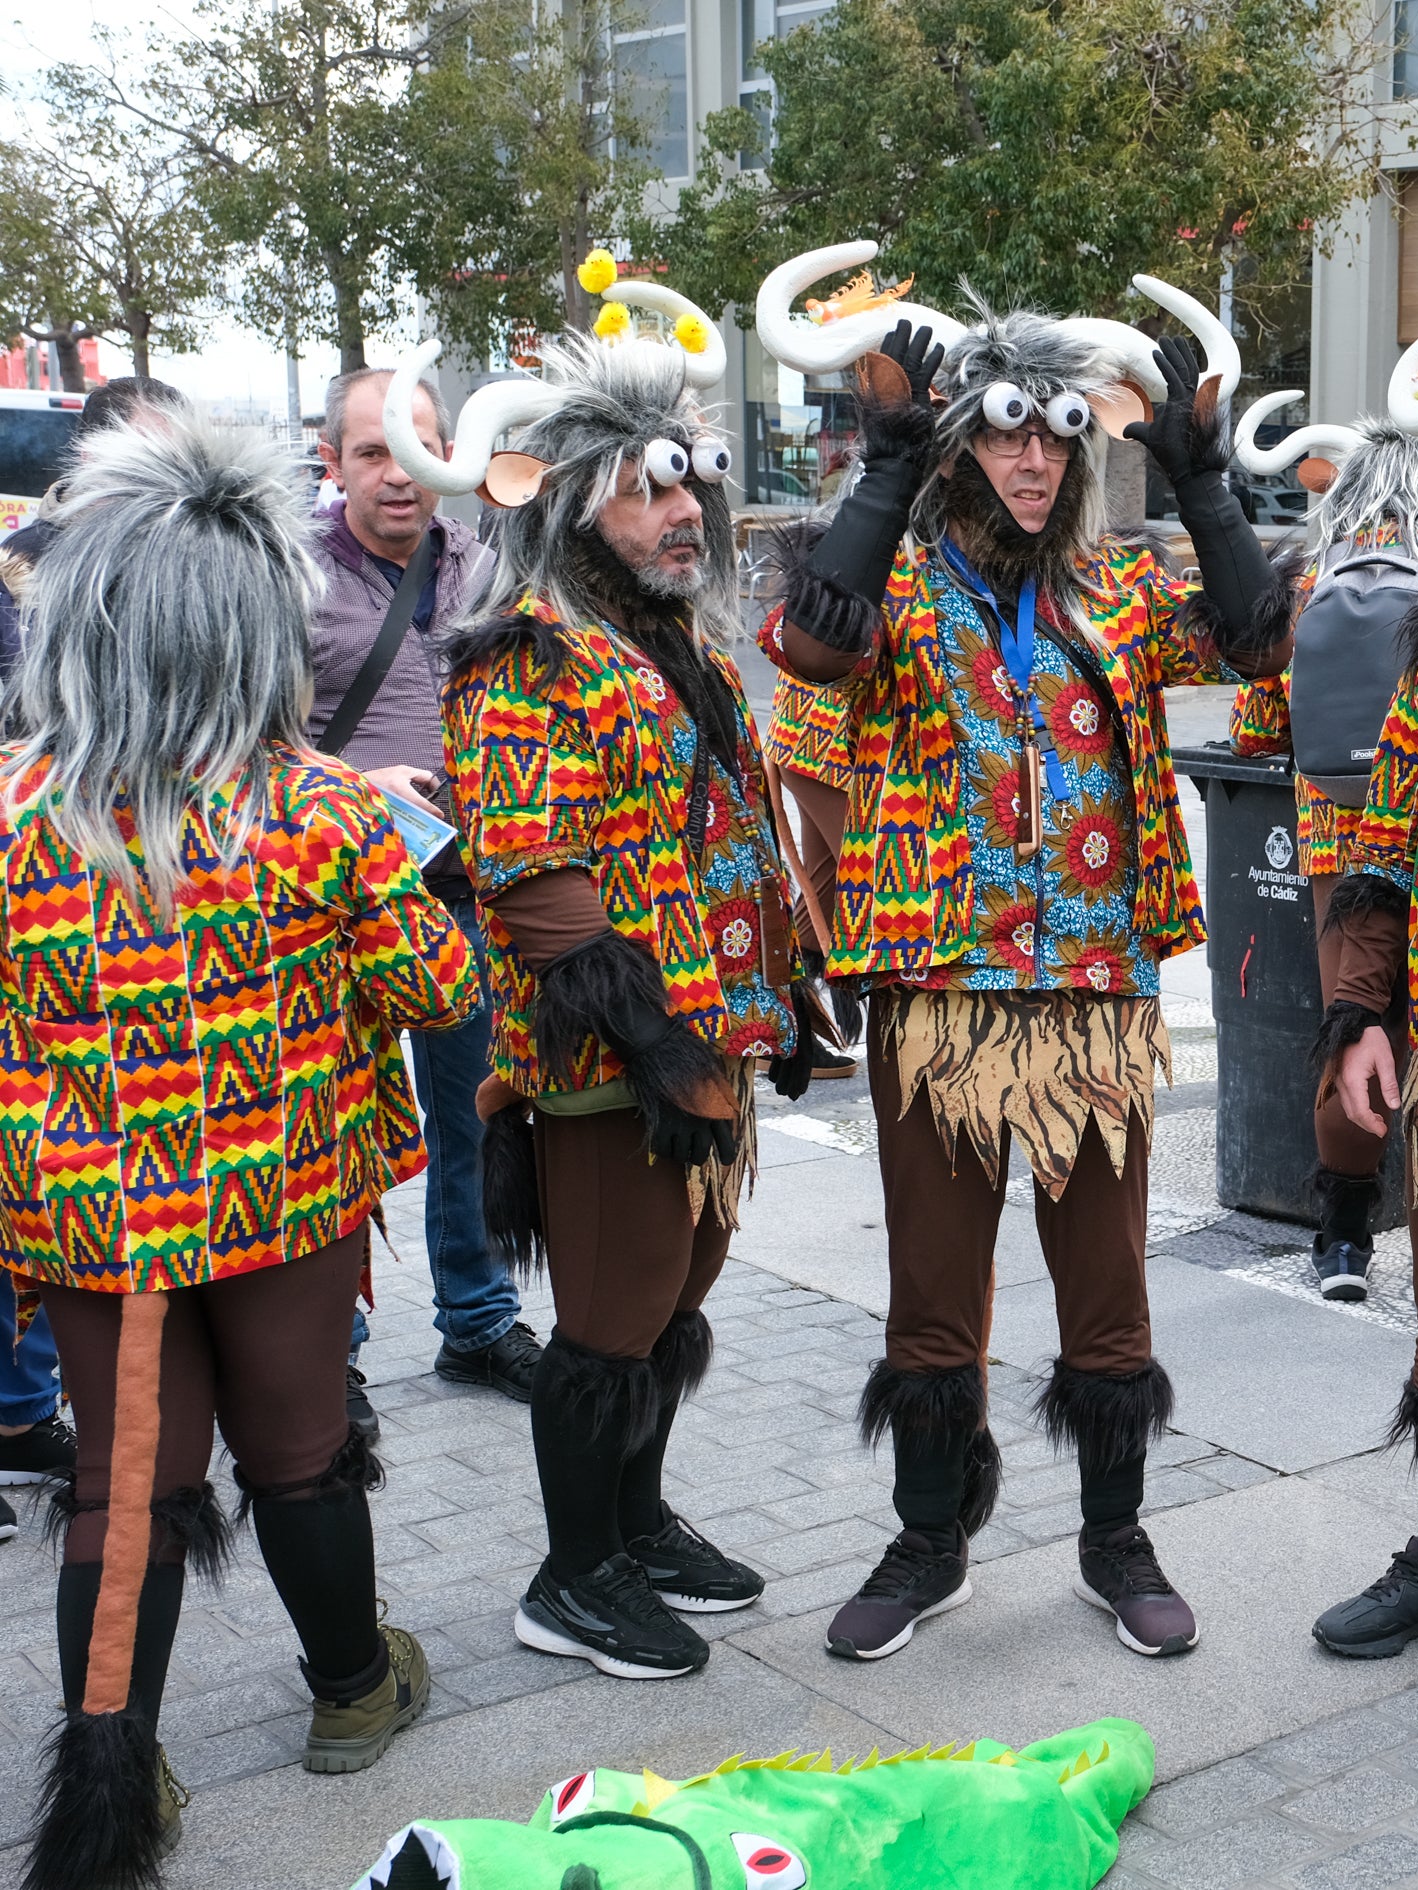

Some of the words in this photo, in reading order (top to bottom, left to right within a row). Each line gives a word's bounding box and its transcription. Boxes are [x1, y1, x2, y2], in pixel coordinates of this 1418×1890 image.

[689, 782, 708, 834] Calvin
[1248, 866, 1309, 887] Ayuntamiento
[1257, 884, 1269, 897] de
[1270, 885, 1298, 901] Cádiz
